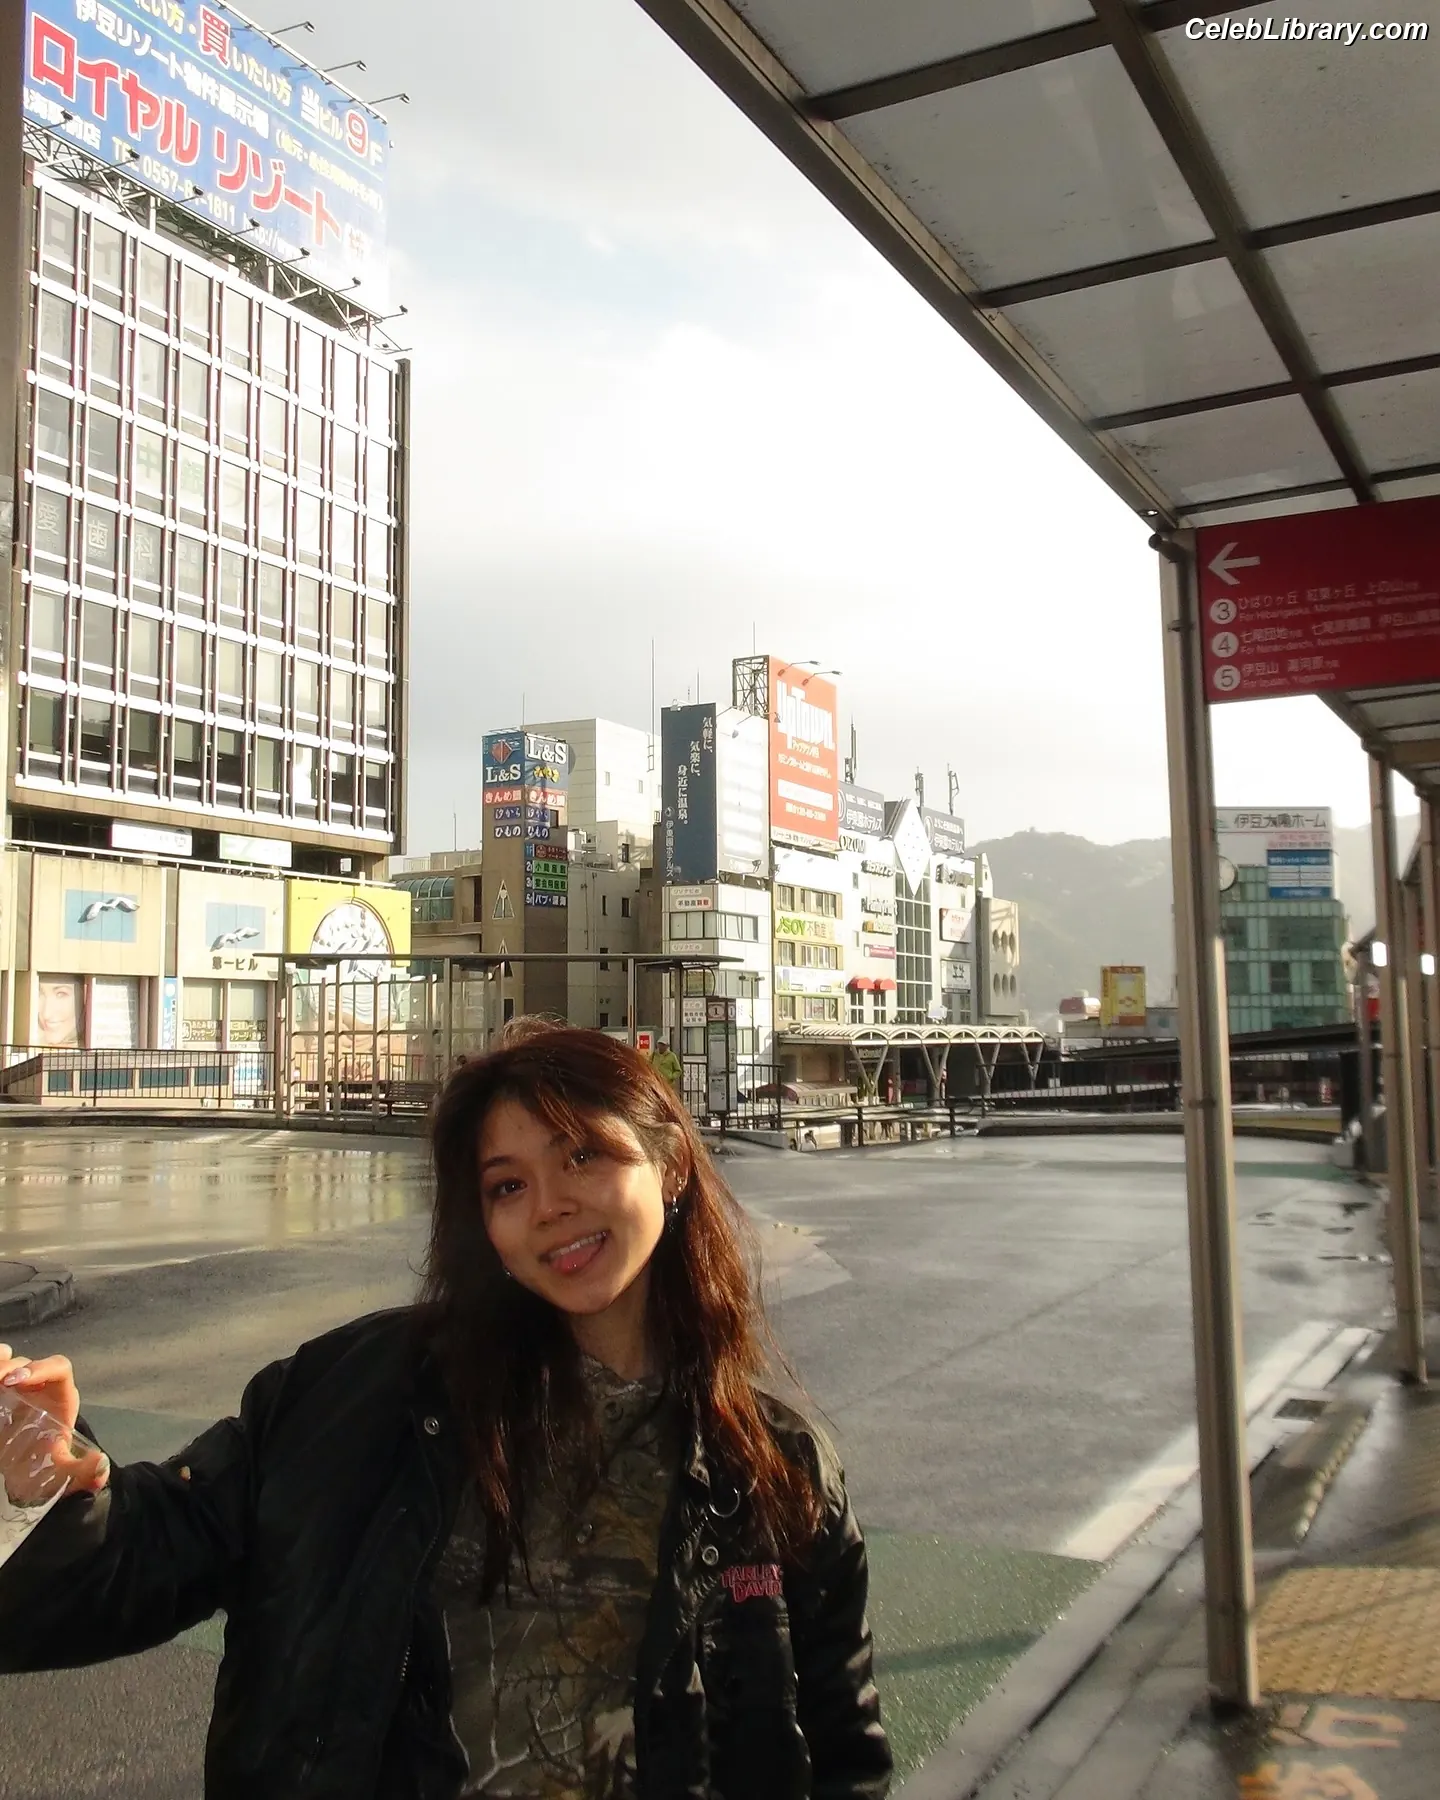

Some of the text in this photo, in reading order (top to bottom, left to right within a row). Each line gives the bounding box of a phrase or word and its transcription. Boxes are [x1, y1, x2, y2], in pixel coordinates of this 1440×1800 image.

[32, 12, 200, 167] ロイヤル
[215, 127, 341, 246] リゾート
[1217, 602, 1230, 620] 3
[1219, 635, 1231, 653] 4
[1221, 669, 1233, 687] 5
[703, 716, 713, 753] 気軽に、
[528, 737, 566, 764] L&S
[690, 740, 701, 776] 気楽に、
[486, 764, 521, 783] L&S
[495, 825, 521, 838] ひもの
[212, 956, 258, 971] 第一ビル
